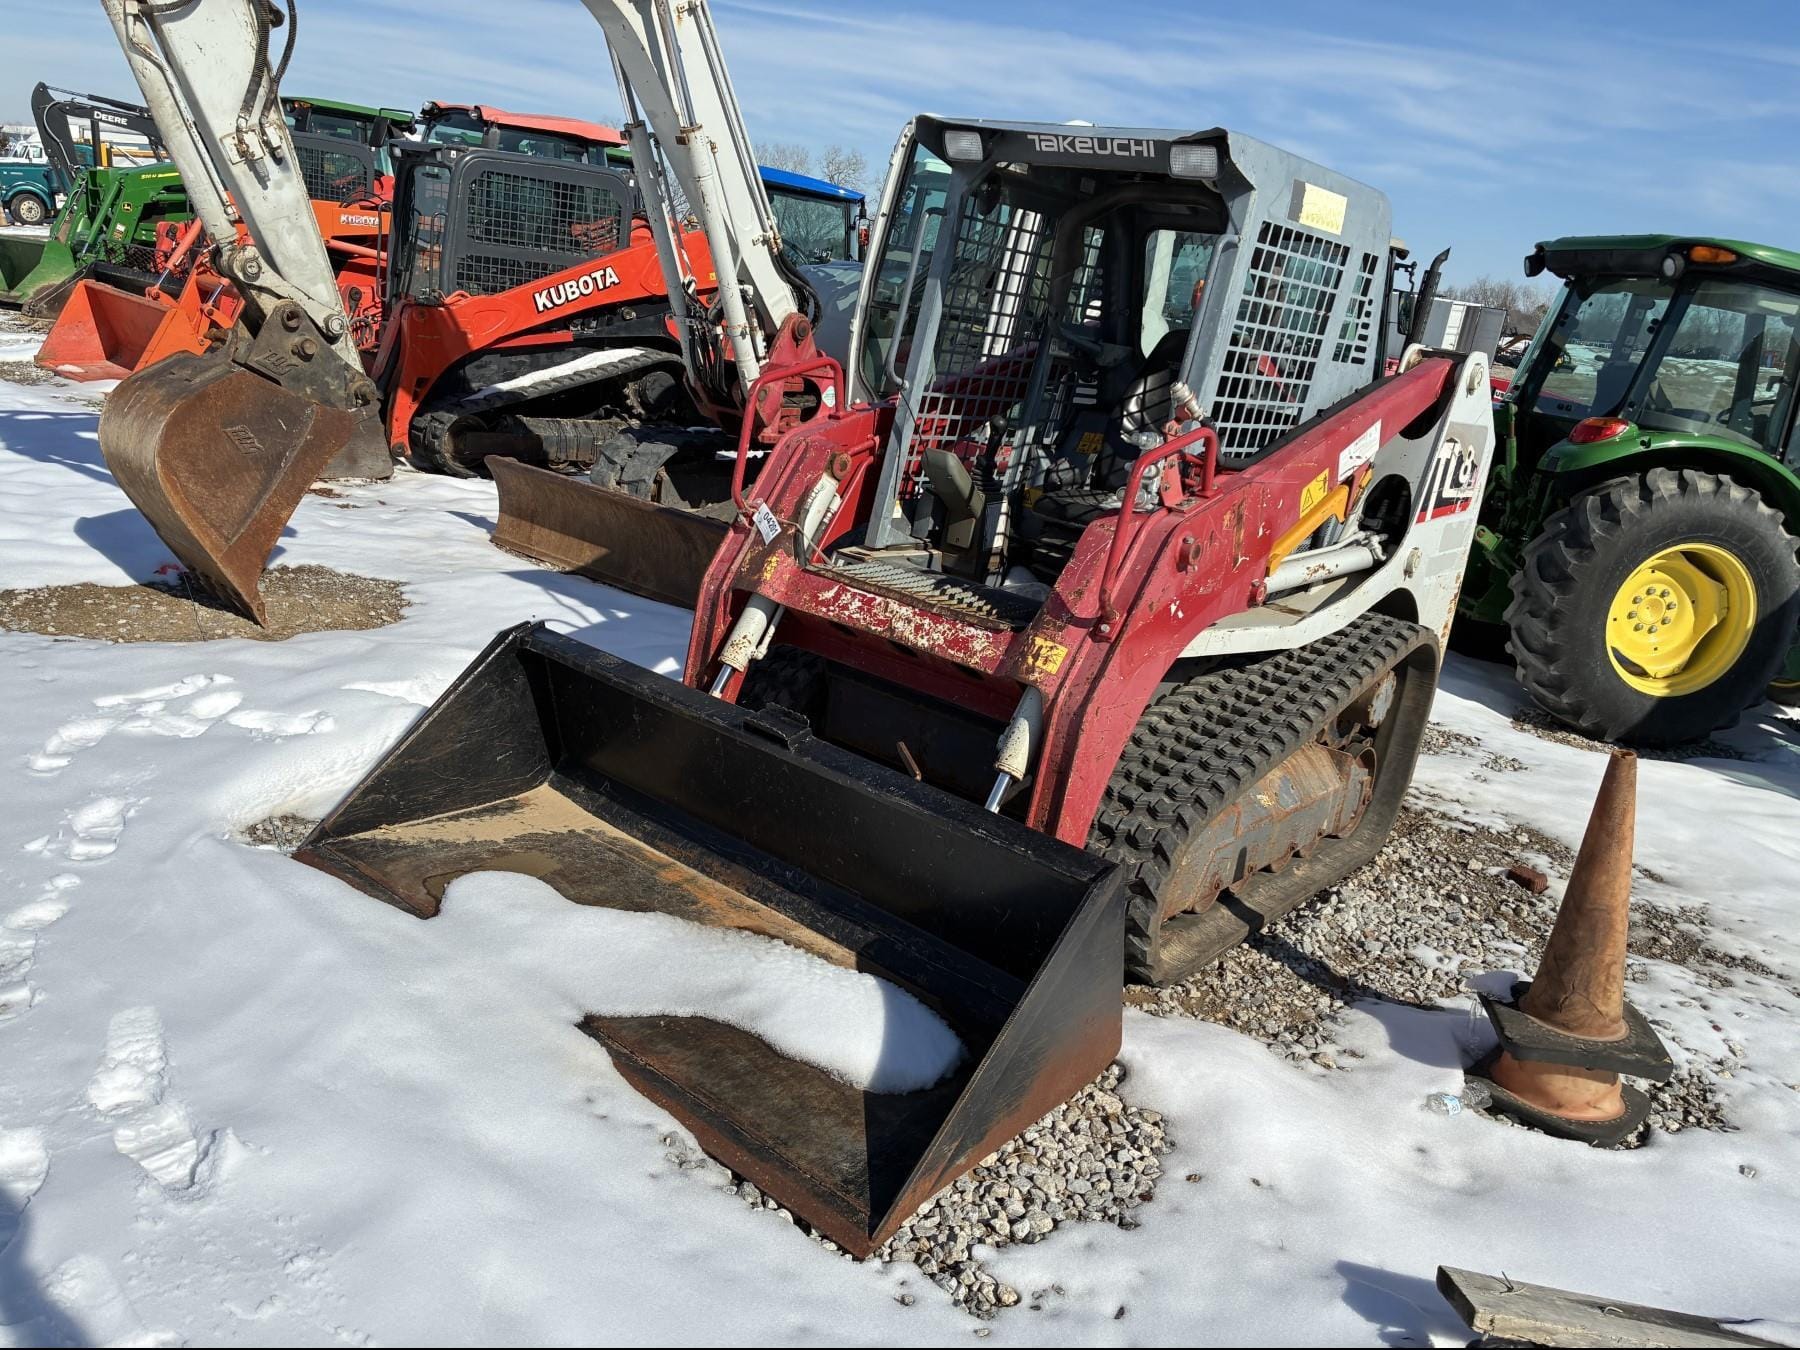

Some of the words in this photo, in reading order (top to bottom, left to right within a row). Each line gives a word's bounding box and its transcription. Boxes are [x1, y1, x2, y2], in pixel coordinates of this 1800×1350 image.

[93, 110, 128, 125] DEERE
[1026, 134, 1155, 158] TAKEUCHI
[533, 266, 620, 312] KUBOTA
